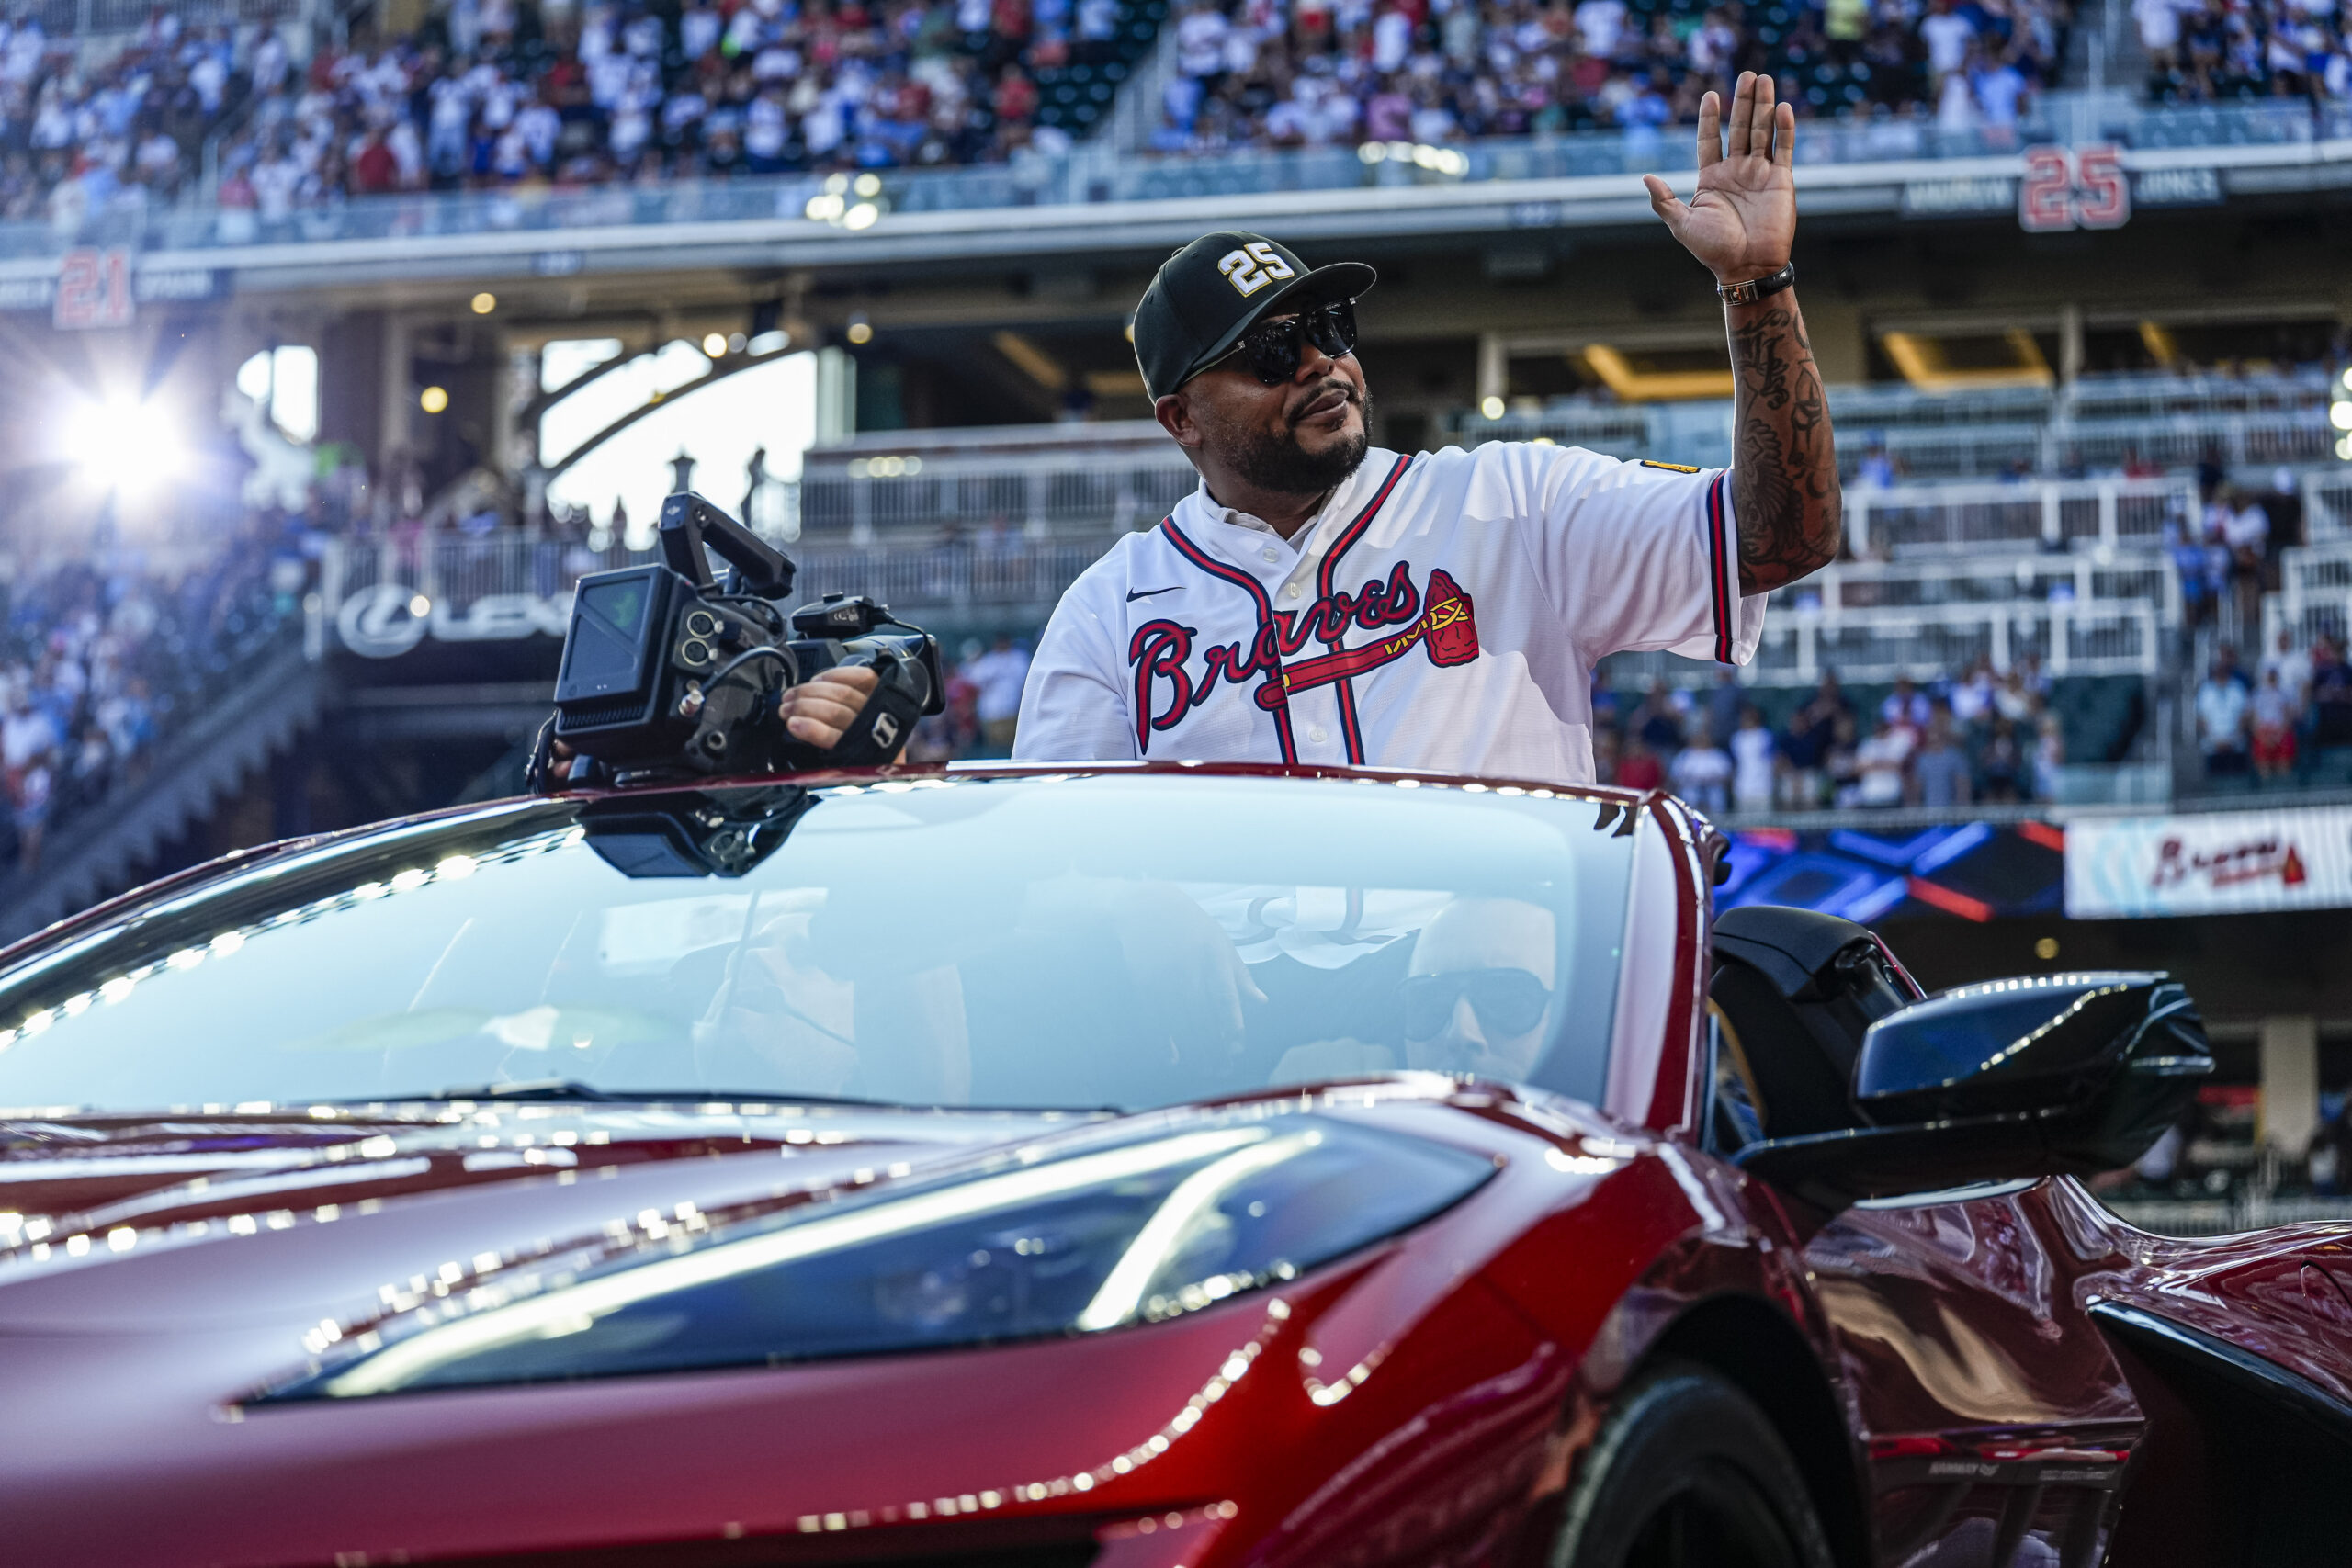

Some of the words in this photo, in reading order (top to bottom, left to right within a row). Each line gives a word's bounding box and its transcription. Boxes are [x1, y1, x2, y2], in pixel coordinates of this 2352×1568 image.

[2020, 143, 2131, 231] 25
[53, 244, 135, 329] 21
[1217, 242, 1295, 298] 25
[429, 590, 575, 641] LEX
[1128, 560, 1421, 755] Braves
